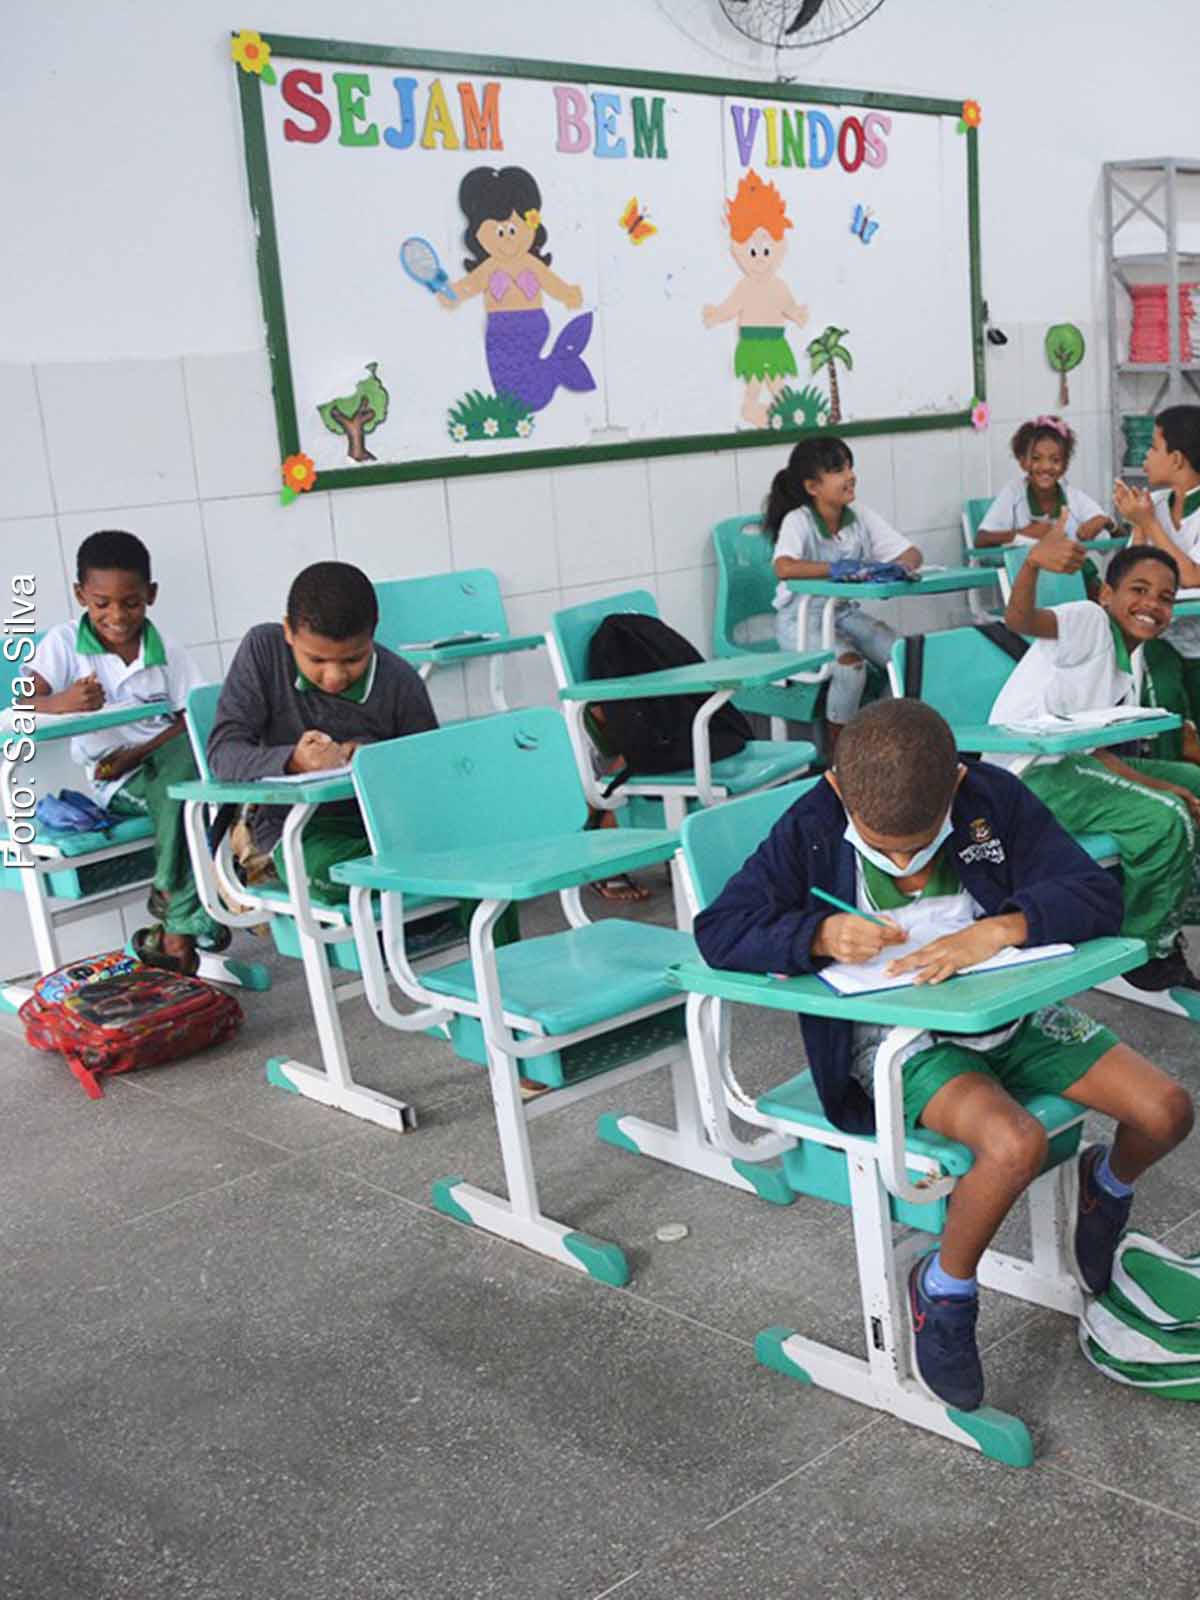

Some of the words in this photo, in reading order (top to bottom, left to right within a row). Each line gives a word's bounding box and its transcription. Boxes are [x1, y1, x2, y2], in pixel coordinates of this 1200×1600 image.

[281, 69, 504, 152] SEJAM
[553, 85, 668, 160] BEM
[730, 105, 893, 173] VINDOS
